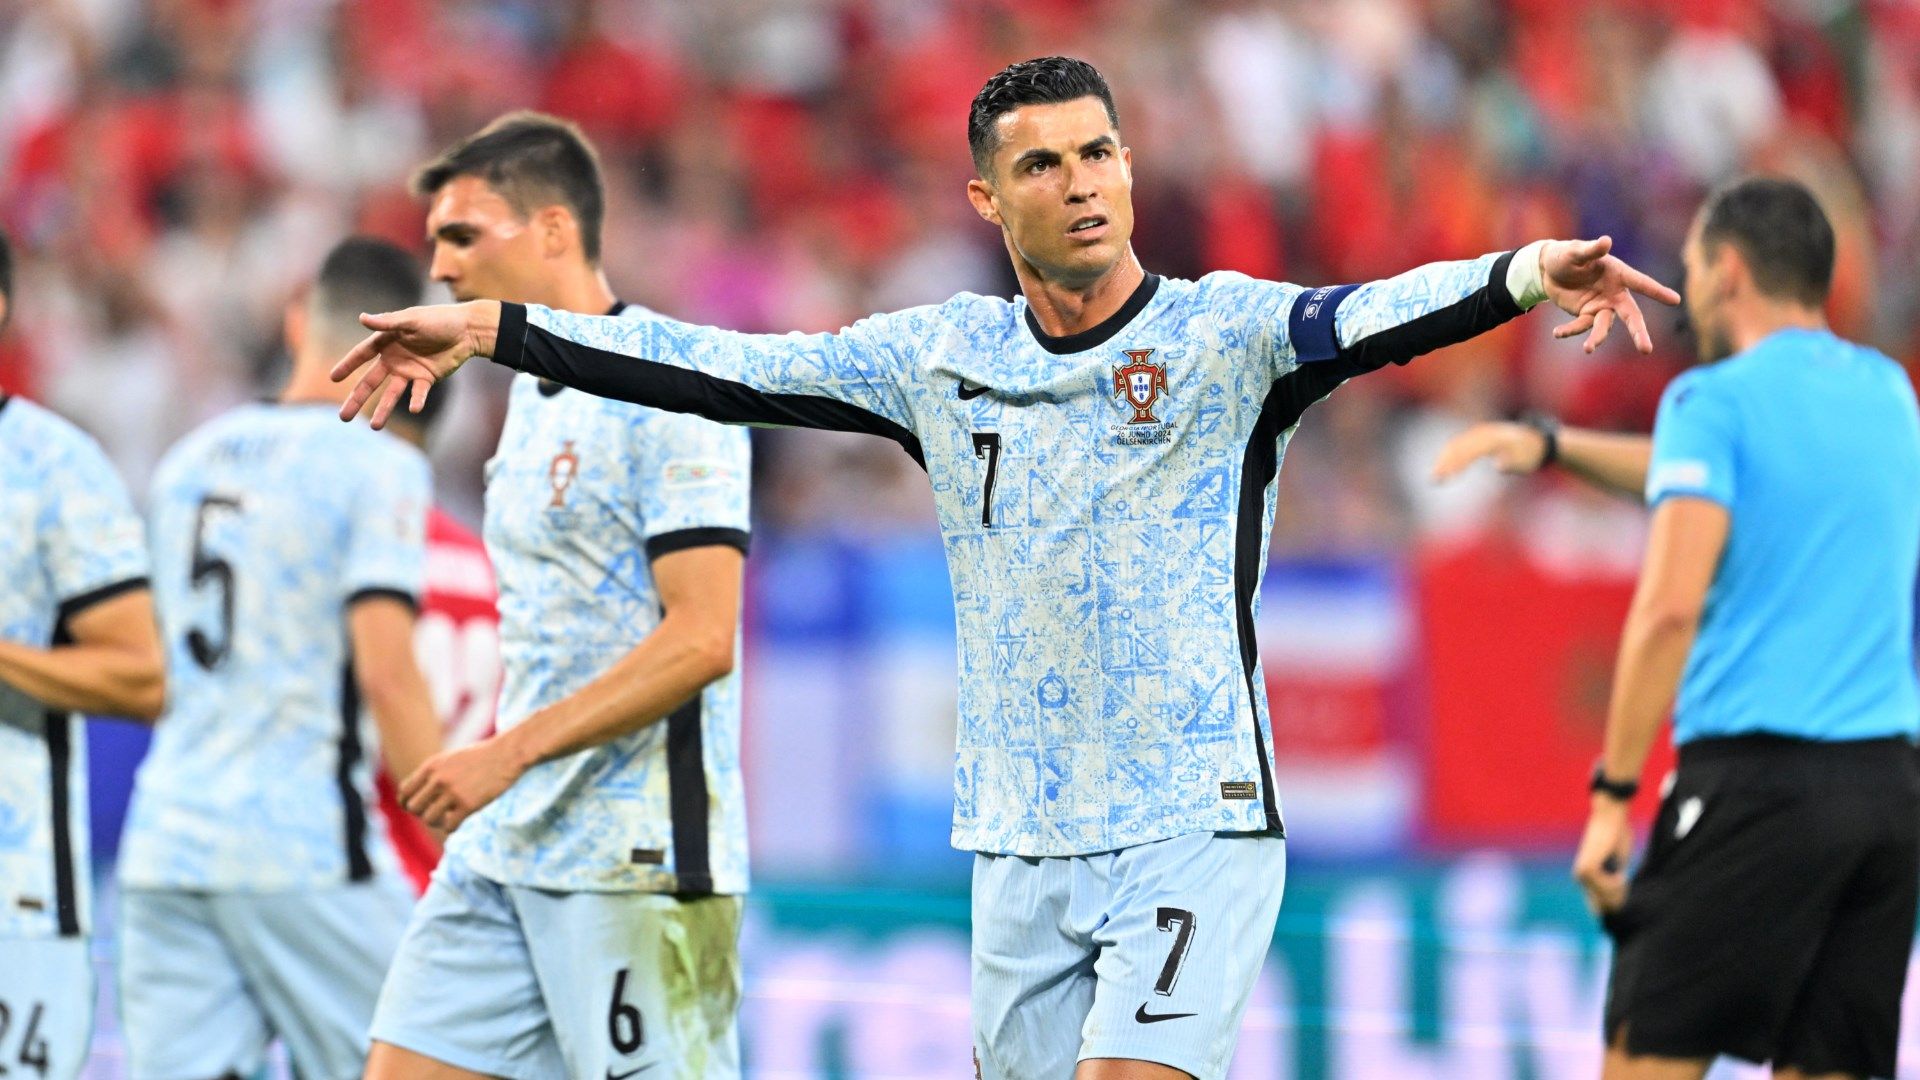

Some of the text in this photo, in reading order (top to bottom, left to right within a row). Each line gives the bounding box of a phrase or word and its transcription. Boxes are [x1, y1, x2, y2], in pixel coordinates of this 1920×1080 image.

[1116, 436, 1172, 446] GELSENKIRCHEN
[1128, 430, 1151, 439] JUNHO
[1153, 429, 1172, 438] 2024
[971, 432, 1002, 529] 7
[185, 494, 241, 672] 5
[1153, 906, 1197, 997] 7
[607, 967, 645, 1056] 6
